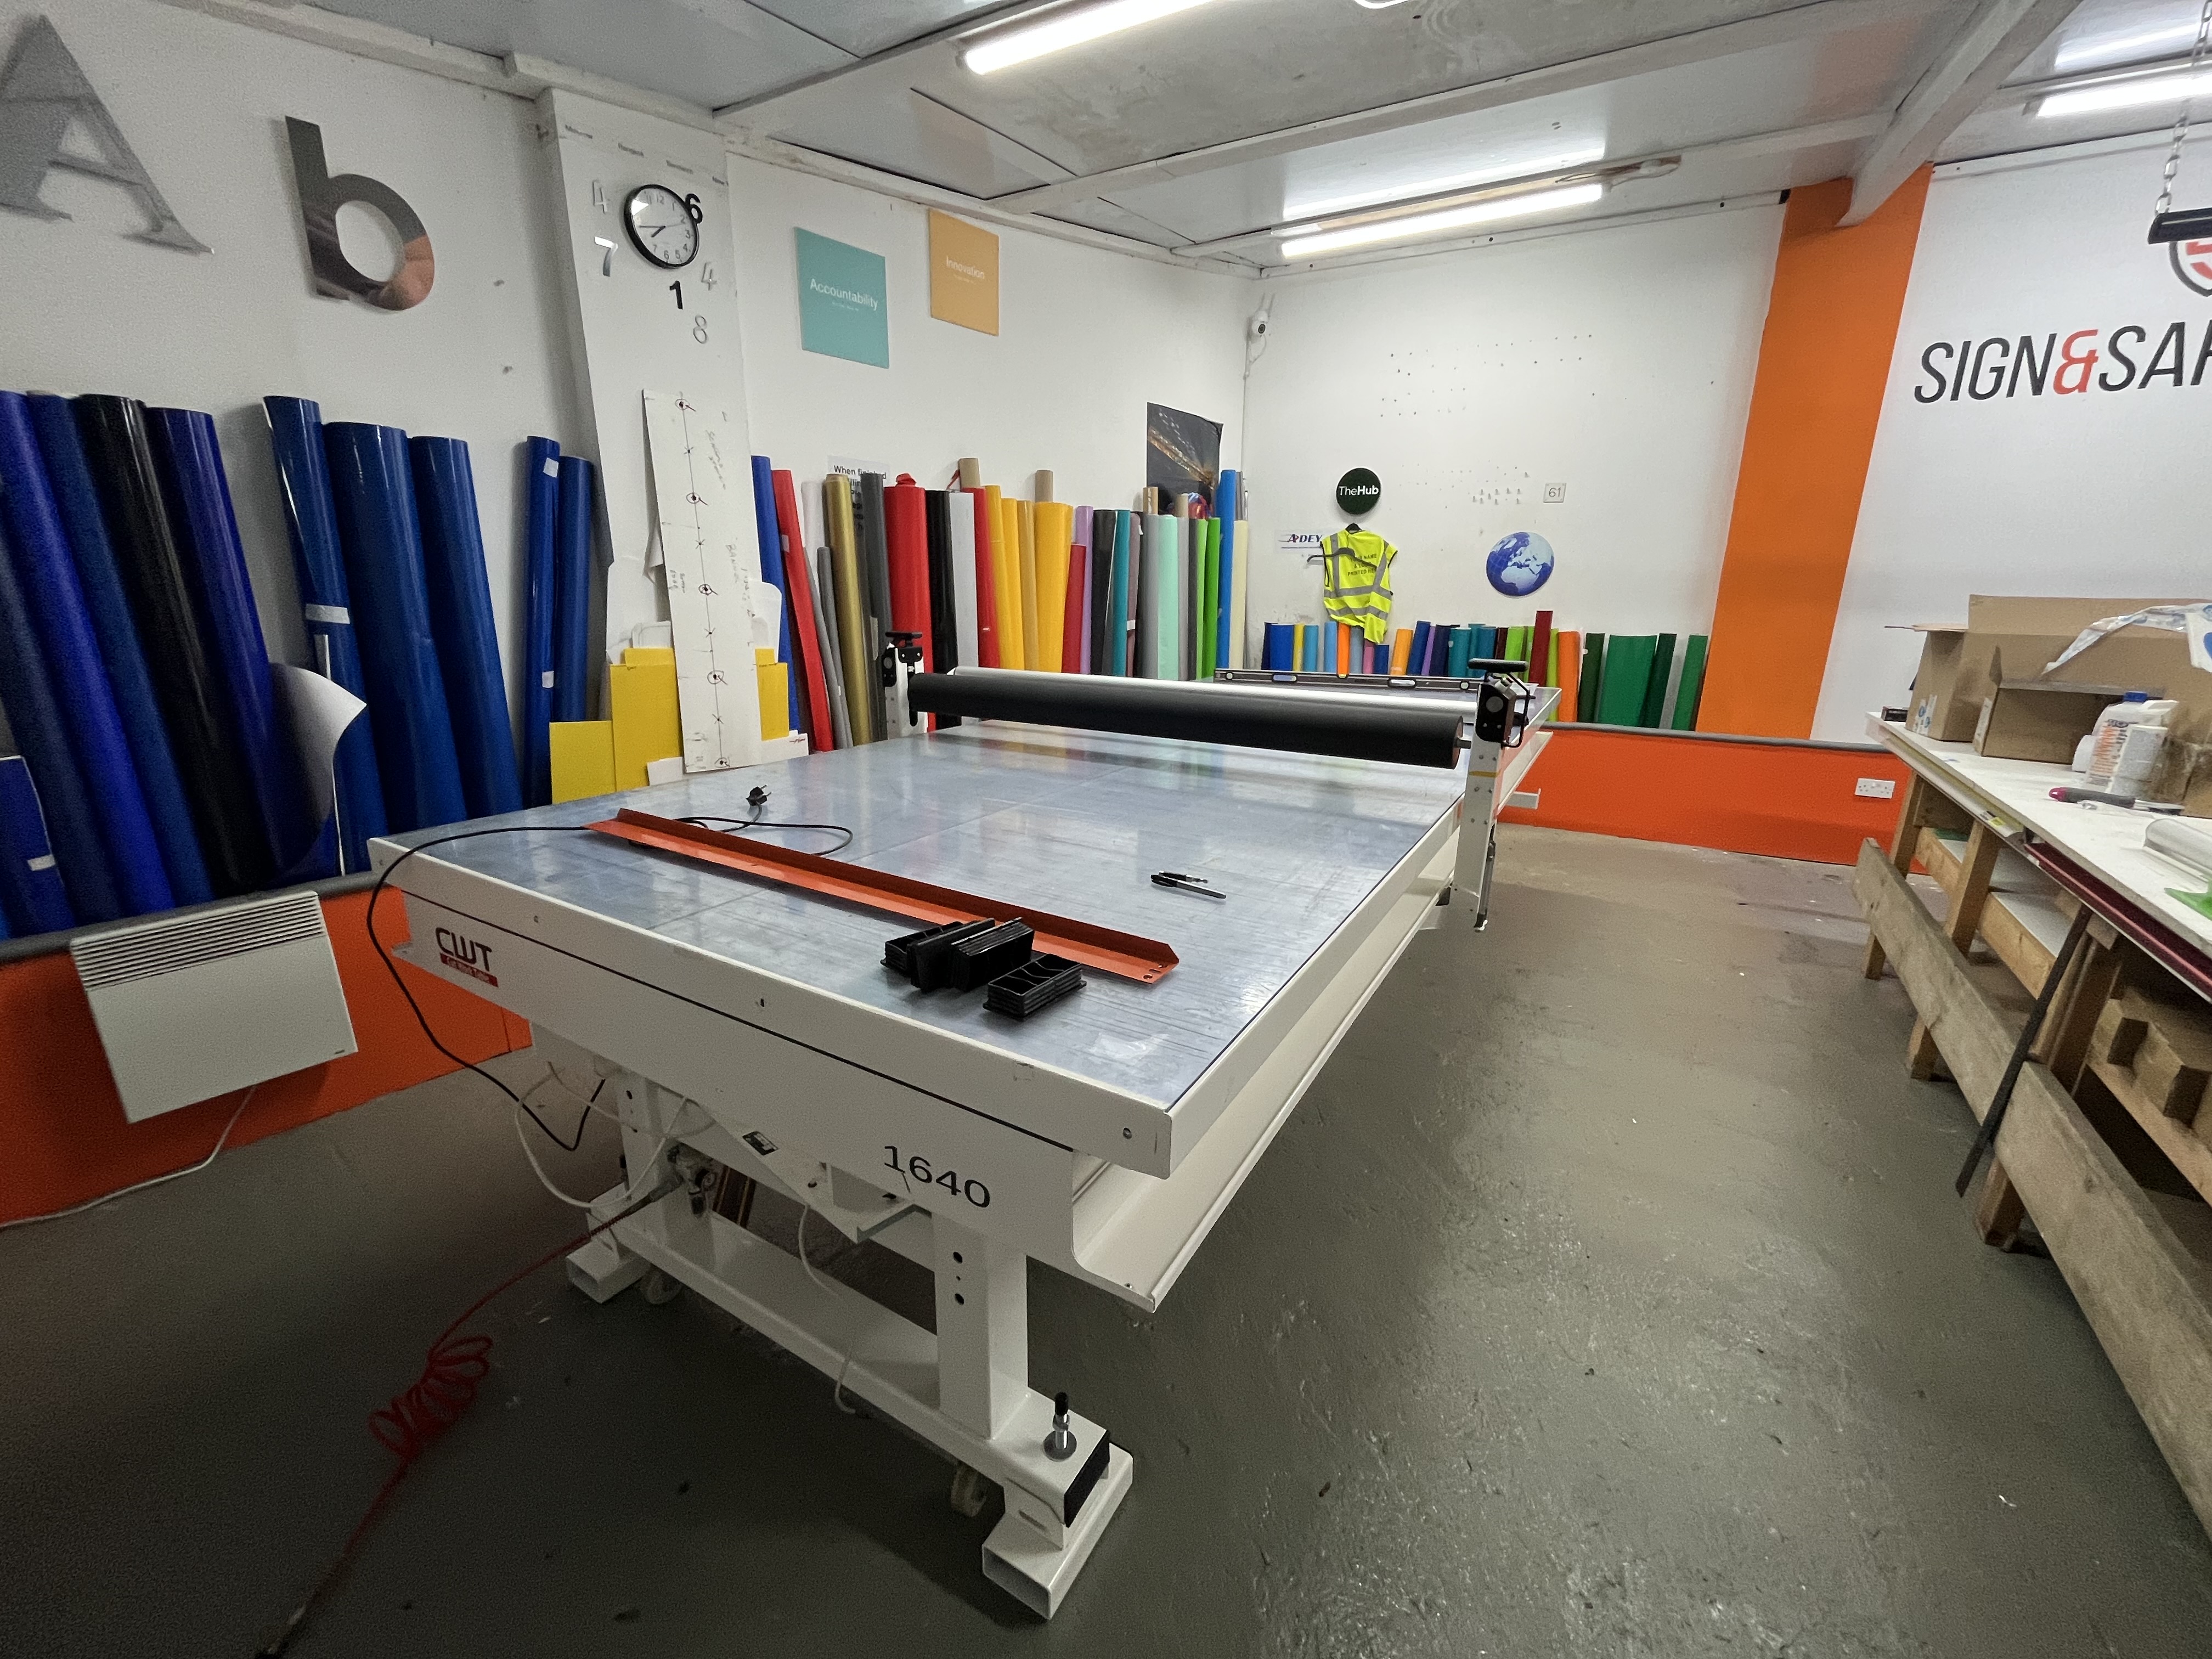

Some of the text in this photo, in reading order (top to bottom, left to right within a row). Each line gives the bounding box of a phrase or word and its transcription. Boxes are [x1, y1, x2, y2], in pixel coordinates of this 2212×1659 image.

[0, 15, 214, 255] A
[285, 116, 435, 311] b
[656, 194, 664, 205] 12
[685, 193, 703, 224] 6
[594, 236, 618, 277] 7
[946, 255, 985, 279] Innovation
[669, 280, 683, 309] 1
[810, 278, 878, 311] Accountability
[693, 314, 708, 343] 8
[833, 465, 856, 475] When
[1339, 485, 1379, 496] TheHub
[1549, 487, 1561, 498] 61
[1288, 534, 1323, 543] ADEY
[884, 1146, 990, 1208] 1640
